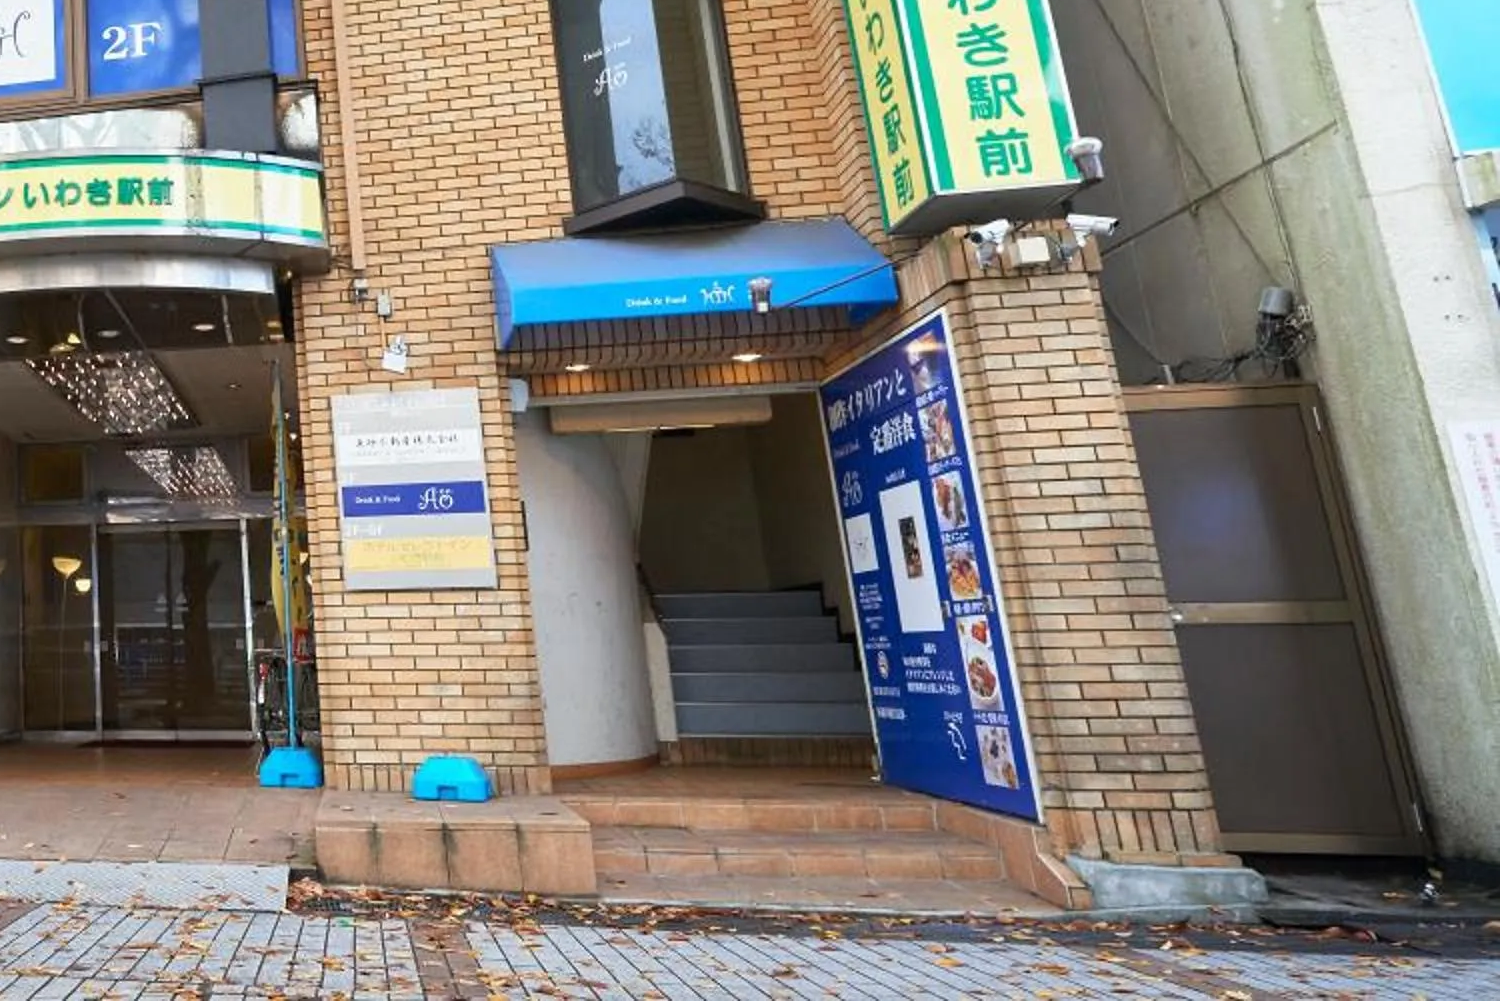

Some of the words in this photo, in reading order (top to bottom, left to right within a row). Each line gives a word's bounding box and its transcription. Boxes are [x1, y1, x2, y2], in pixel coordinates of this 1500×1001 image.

[102, 21, 163, 61] 2F
[22, 177, 175, 209] いわき駅前
